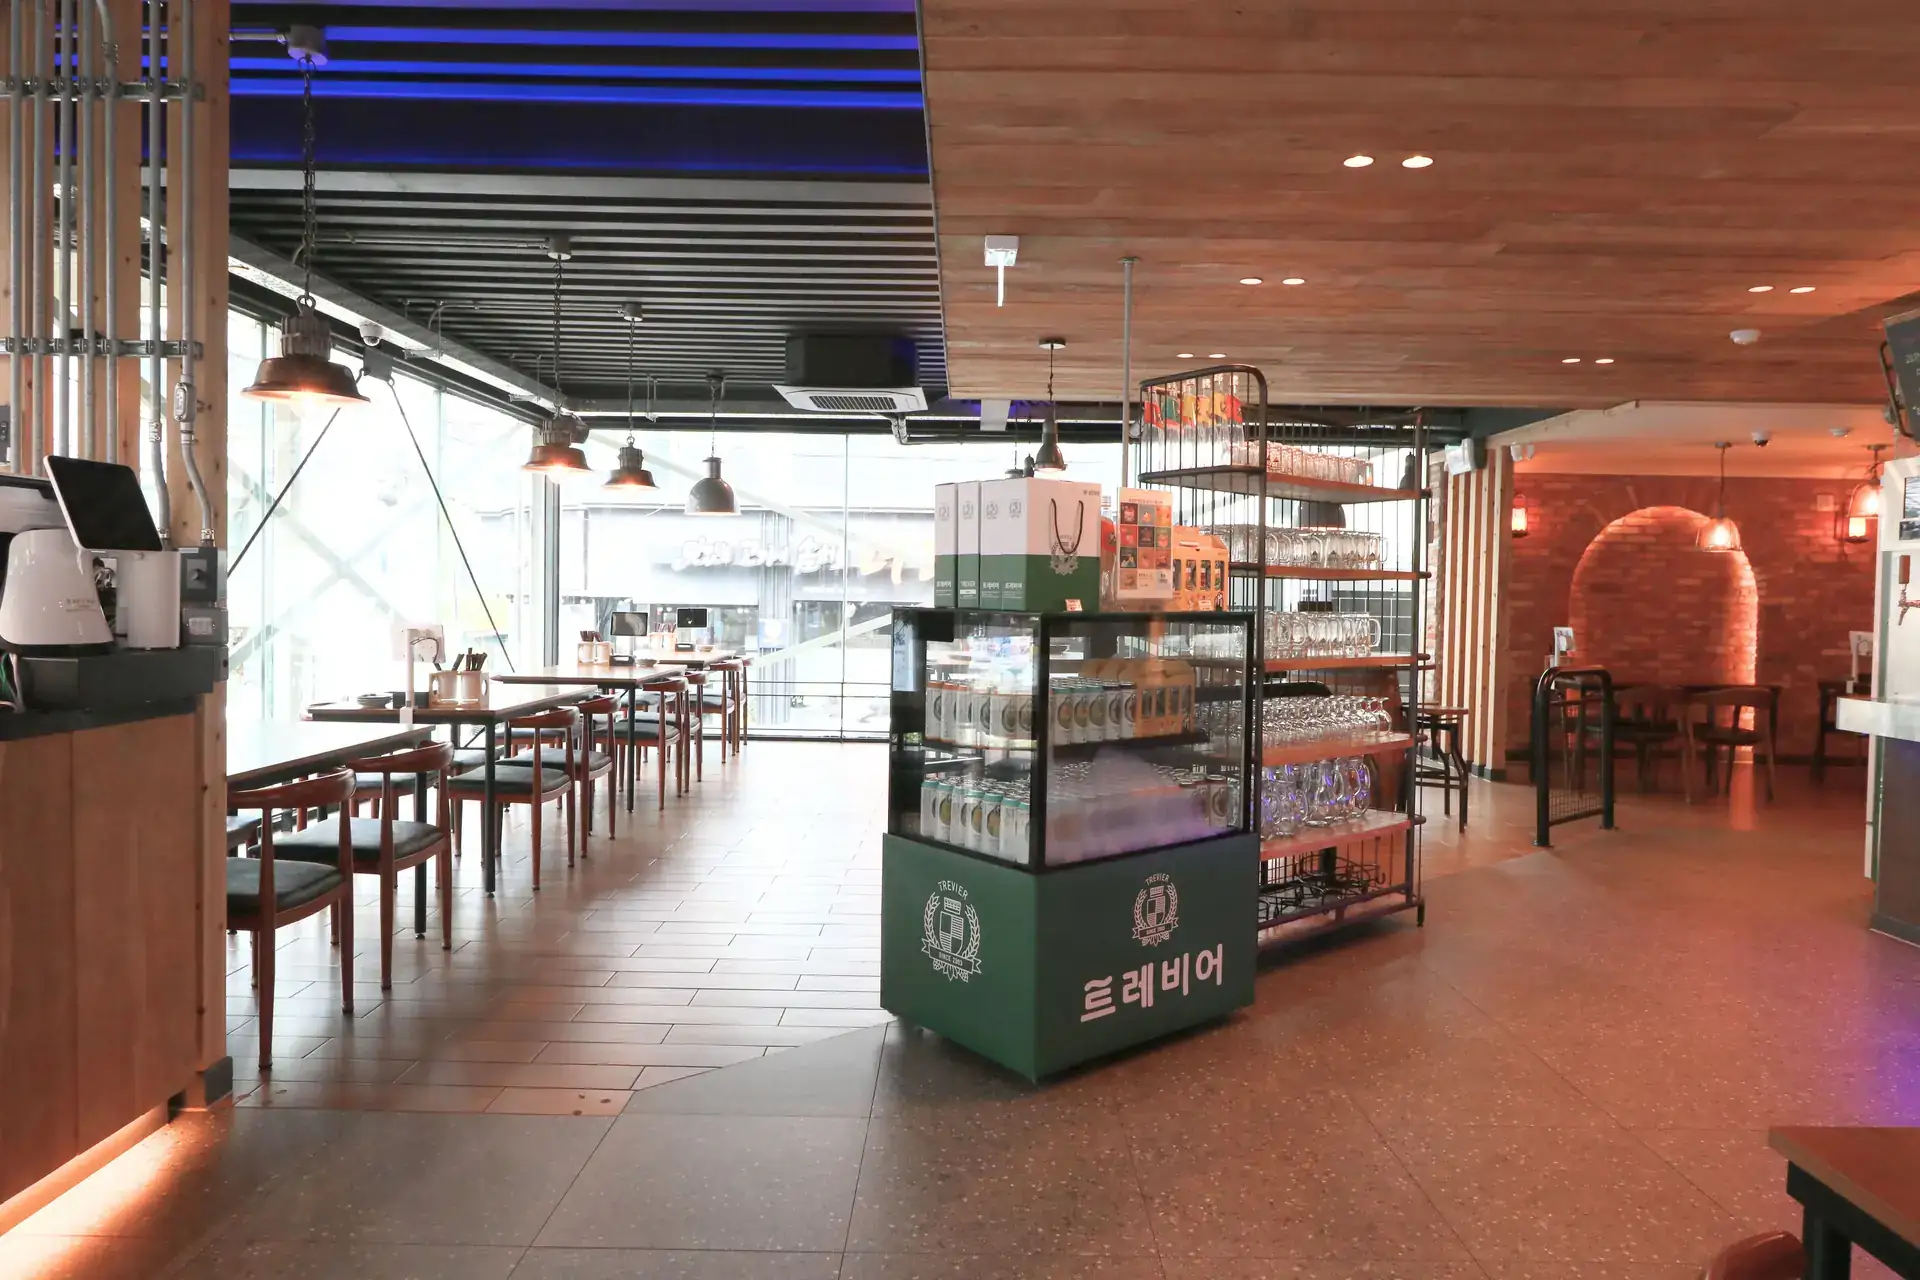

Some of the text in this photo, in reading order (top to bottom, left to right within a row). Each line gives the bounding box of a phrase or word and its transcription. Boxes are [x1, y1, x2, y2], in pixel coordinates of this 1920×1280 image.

[1145, 873, 1169, 885] TREVIER
[938, 880, 968, 899] TREVIER
[939, 952, 952, 962] SINCE
[1080, 943, 1223, 1023] 트레비어
